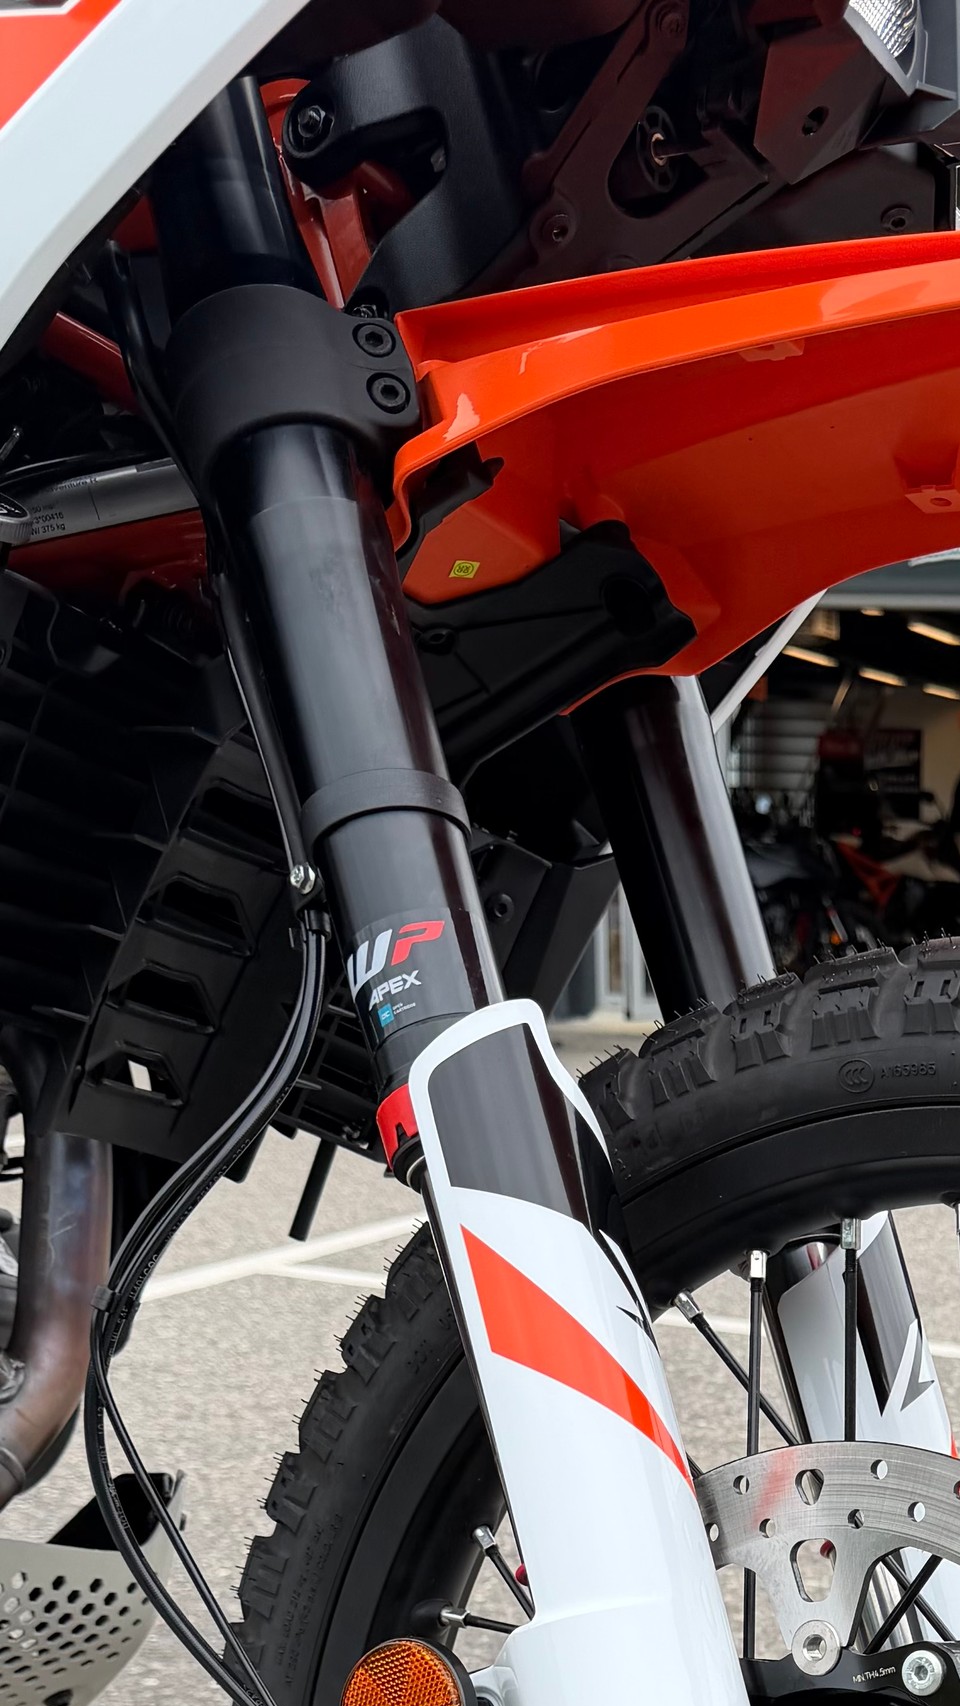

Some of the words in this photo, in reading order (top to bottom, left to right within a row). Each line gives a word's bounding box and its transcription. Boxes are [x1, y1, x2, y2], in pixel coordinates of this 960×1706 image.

[56, 522, 66, 532] kg
[347, 920, 446, 1003] WP
[368, 969, 422, 1011] APEX
